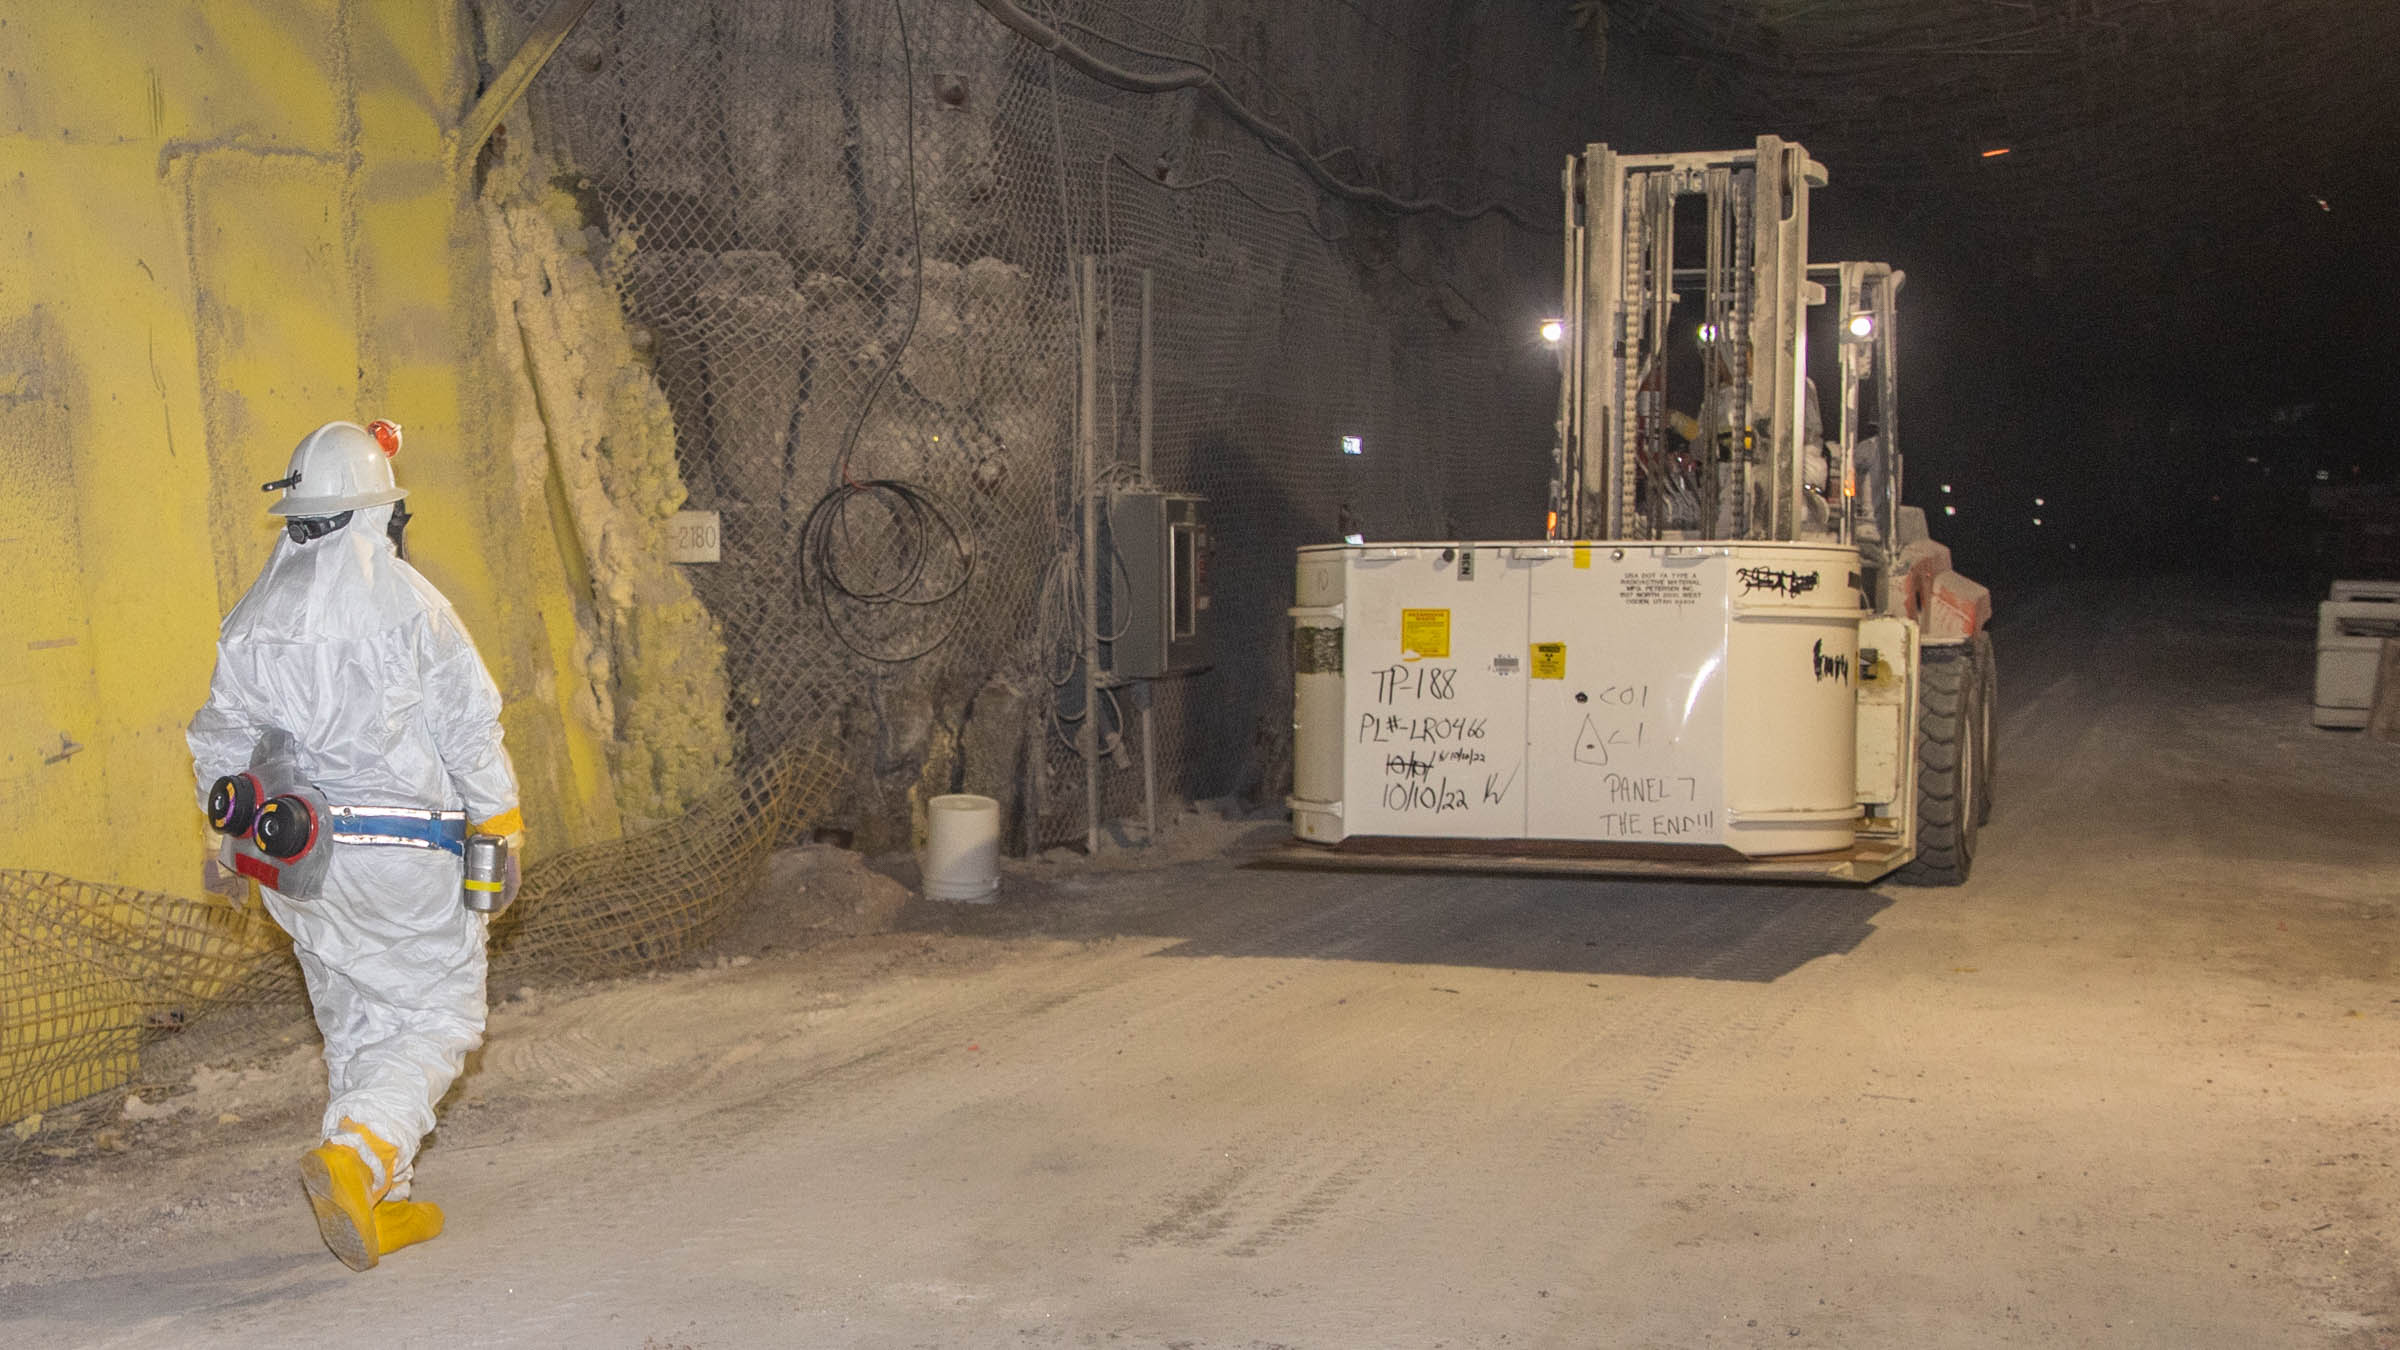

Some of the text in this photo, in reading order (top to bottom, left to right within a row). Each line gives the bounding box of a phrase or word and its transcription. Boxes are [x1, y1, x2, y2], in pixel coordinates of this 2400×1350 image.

[1371, 664, 1457, 705] TP-188
[1603, 773, 1696, 803] PANEL 7
[1600, 812, 1643, 836] THE
